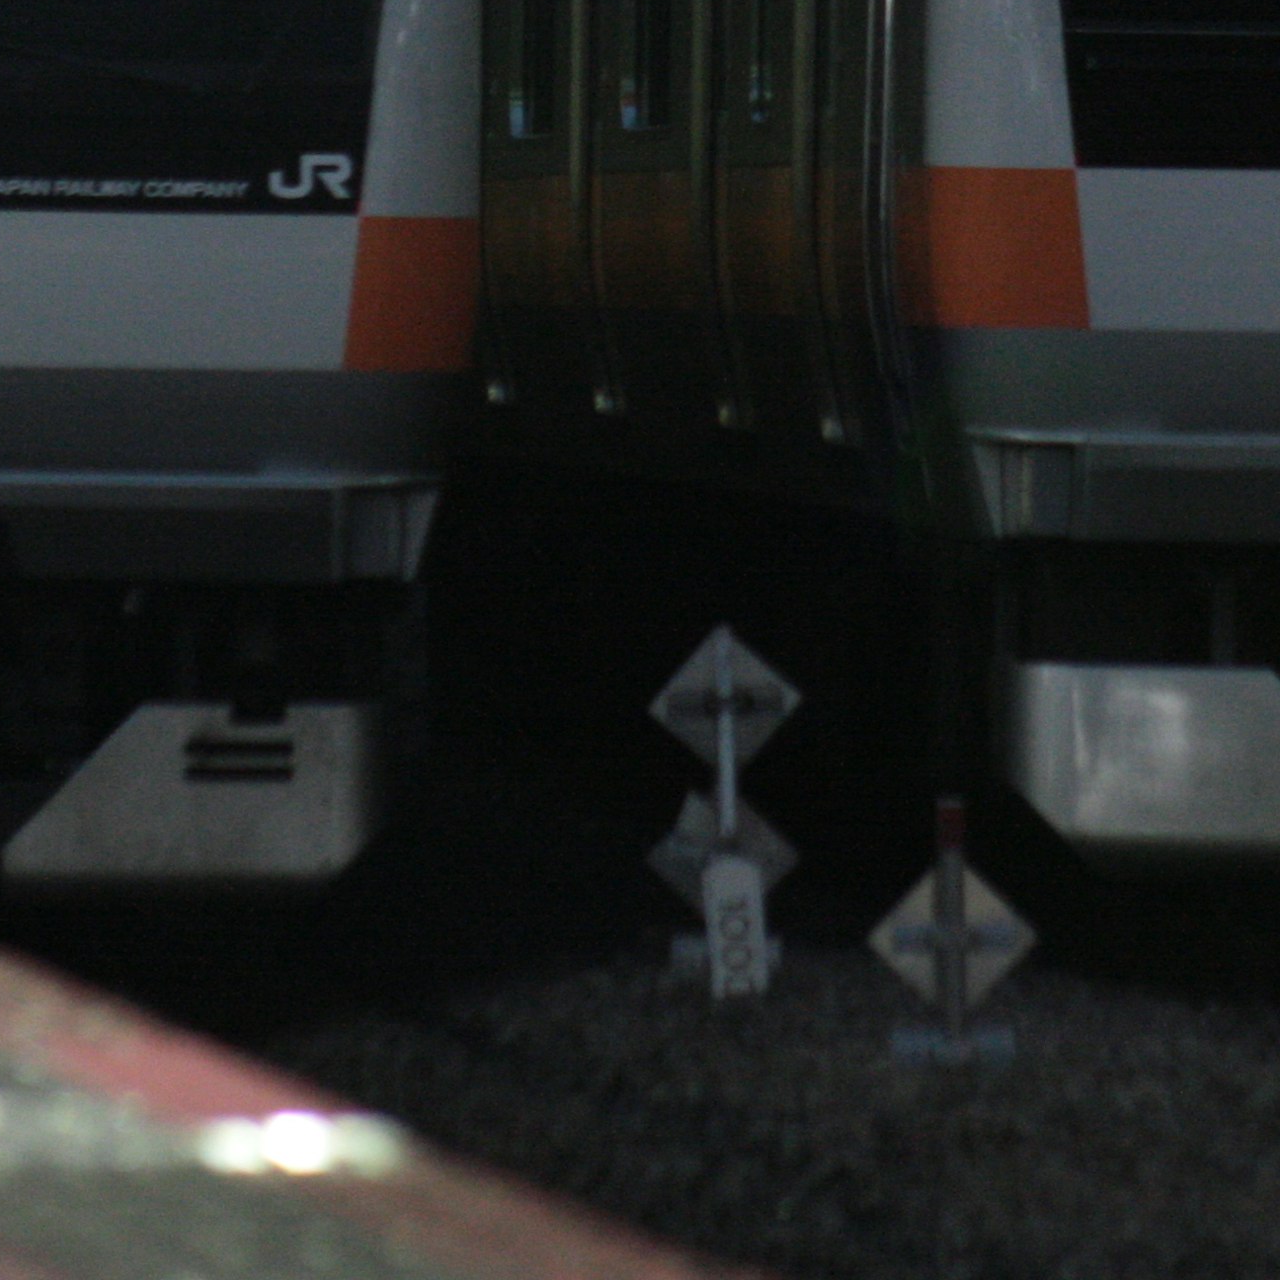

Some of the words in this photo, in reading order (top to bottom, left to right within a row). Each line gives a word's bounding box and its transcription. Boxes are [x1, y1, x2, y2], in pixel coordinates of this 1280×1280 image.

[53, 179, 141, 198] RAILWAY
[144, 180, 250, 199] COMPANY
[267, 153, 354, 200] JR
